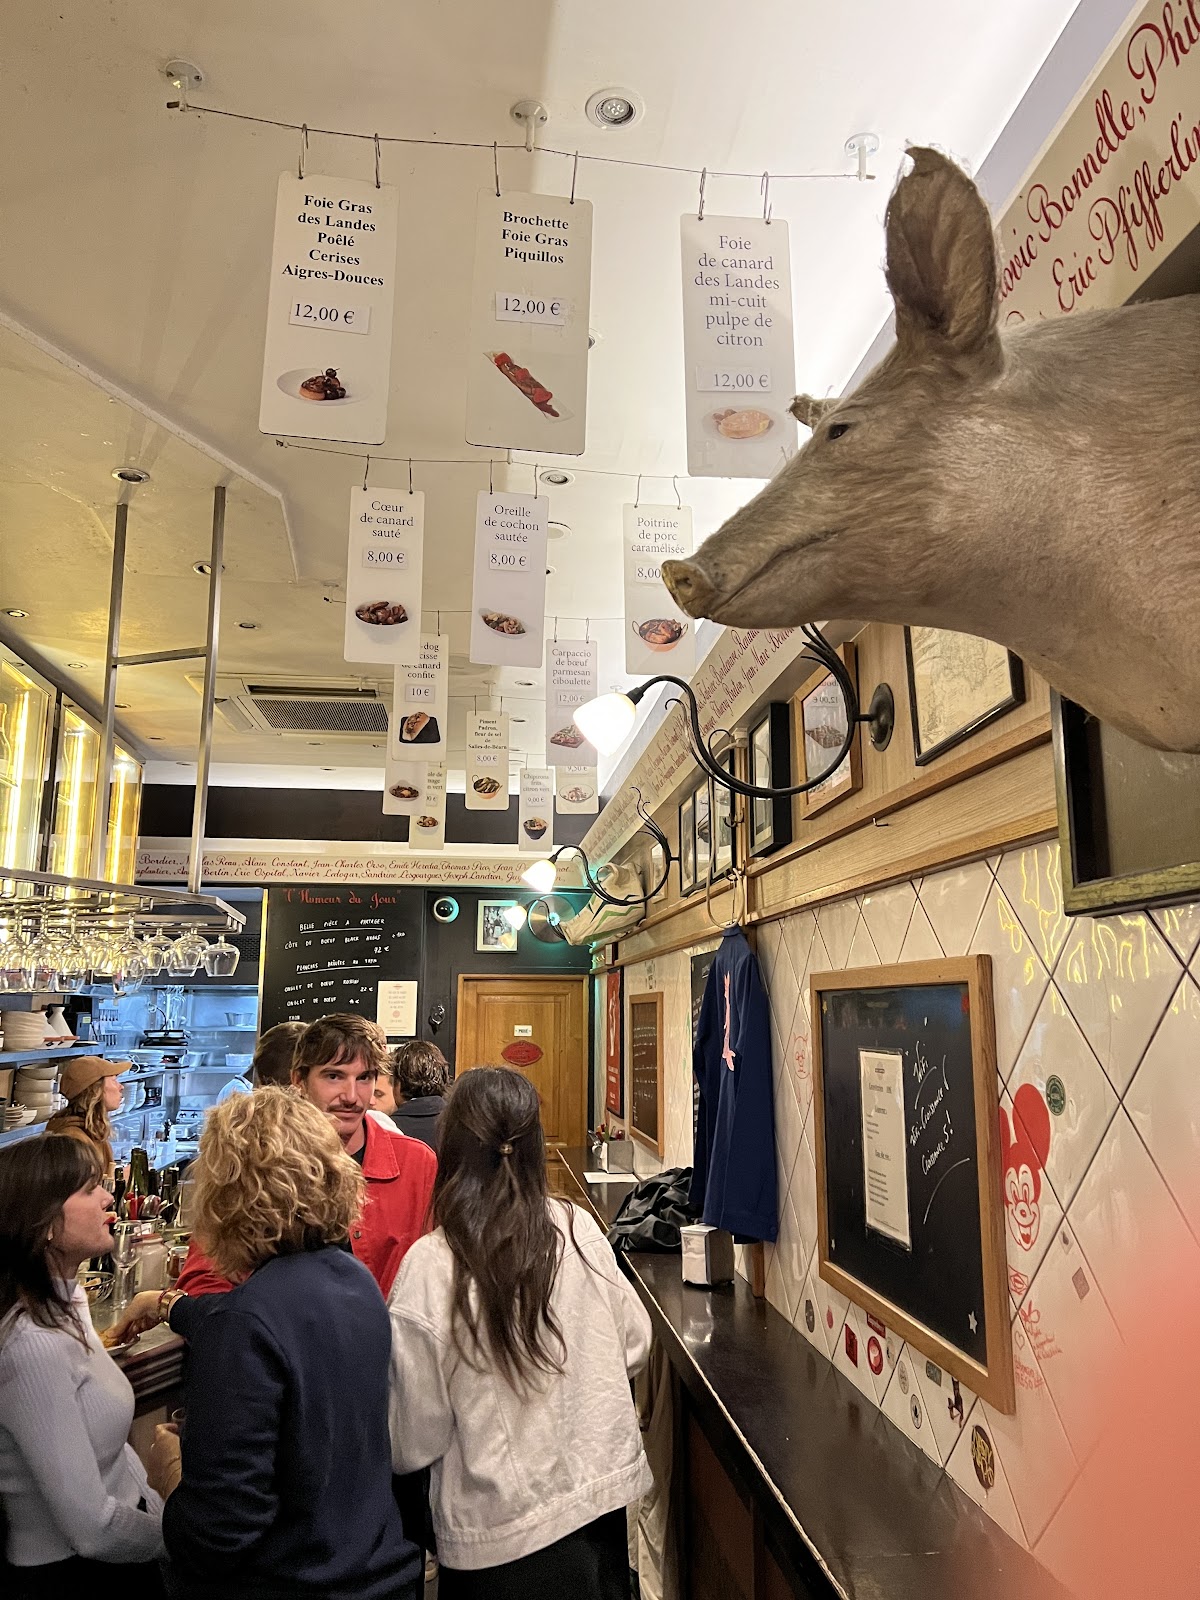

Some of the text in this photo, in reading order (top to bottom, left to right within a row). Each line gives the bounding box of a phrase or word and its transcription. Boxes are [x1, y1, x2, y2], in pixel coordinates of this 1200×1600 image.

[1027, 89, 1146, 242] Bonnelle,
[304, 194, 373, 214] Foie Gras
[297, 212, 376, 232] des Landes
[503, 211, 569, 230] Brochette
[317, 231, 355, 247] Poêlé
[501, 228, 569, 248] Foie Gras
[719, 235, 751, 251] Foie
[309, 249, 360, 265] Cerises
[504, 247, 564, 265] Piquillos
[698, 253, 774, 271] de canard
[281, 264, 384, 287] Aigres-Douces
[694, 272, 780, 290] des Landes
[1053, 252, 1097, 312] Eric
[503, 297, 561, 316] 12,00 €
[709, 293, 767, 308] mi-cuit
[294, 303, 355, 324] 12,00 €
[706, 312, 773, 330] pulpe de
[716, 331, 763, 347] citron
[713, 374, 769, 390] 12,00 €
[371, 501, 404, 513] Cœur
[494, 504, 531, 517] Oreille
[360, 513, 414, 527] de canard
[484, 517, 540, 531] de cochon
[637, 517, 679, 529] Poitrine
[372, 528, 401, 539] sauté
[494, 532, 528, 543] sautée
[638, 531, 678, 543] de porc
[631, 542, 685, 555] caramélisée
[367, 550, 405, 564] 8,00 €
[490, 553, 527, 567] 8,00 €
[637, 567, 661, 580] 8,00
[552, 649, 591, 659] Carpaccio
[555, 658, 565, 666] de
[408, 671, 435, 679] confite
[552, 669, 591, 677] parmesan
[552, 677, 591, 685] ciboulette
[412, 687, 430, 697] 10 €
[559, 694, 578, 703] 12,00
[349, 891, 362, 904] du
